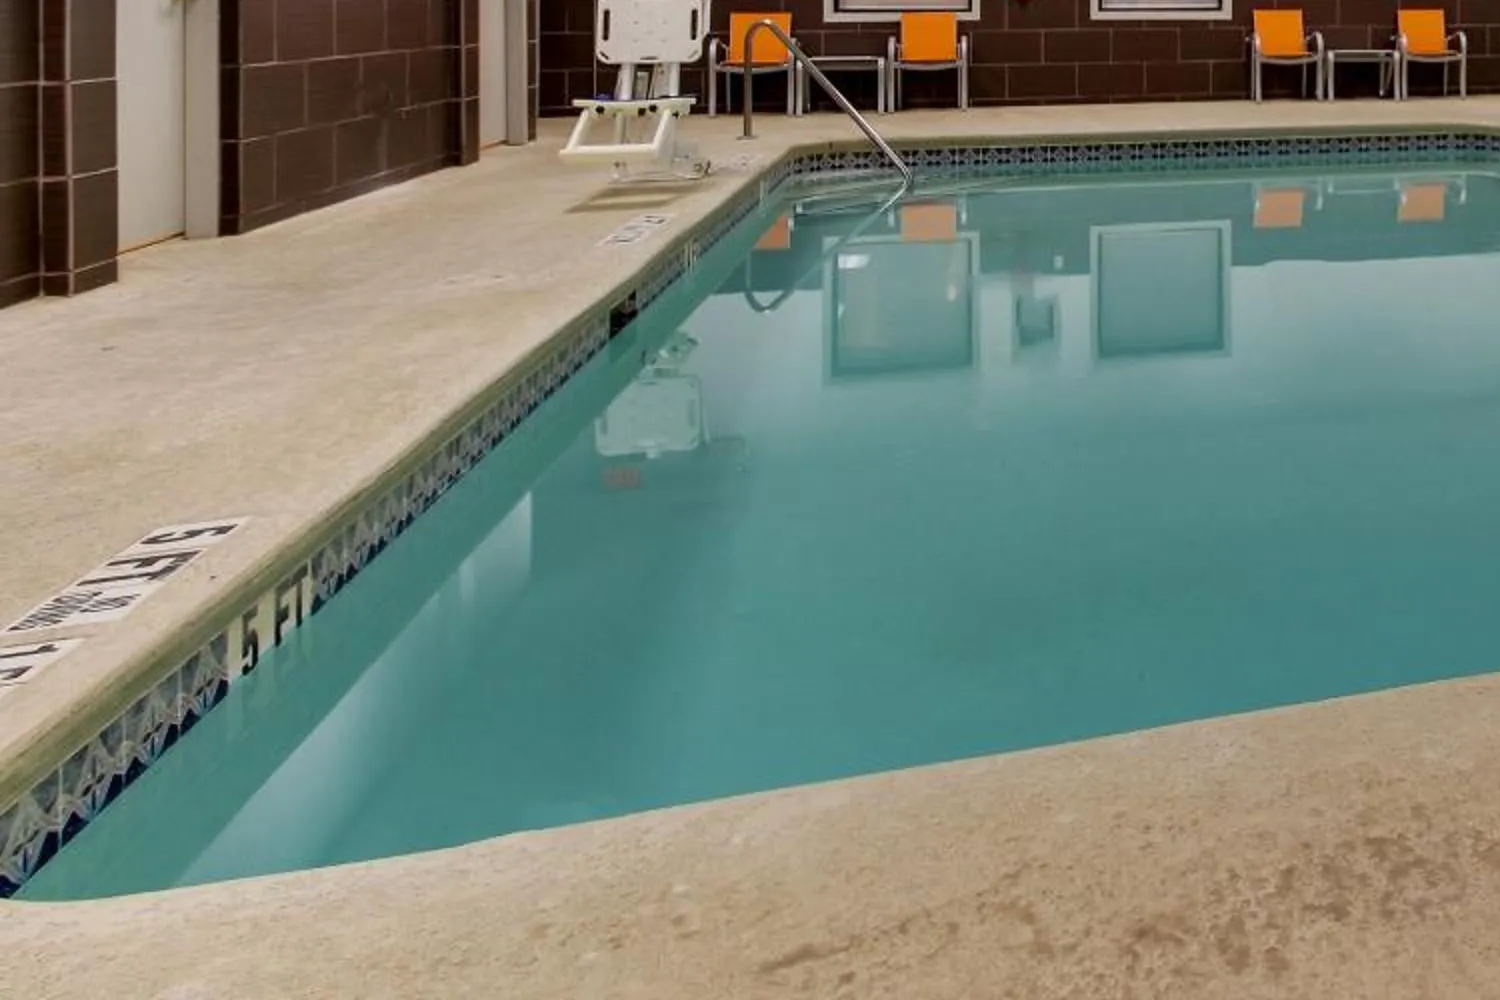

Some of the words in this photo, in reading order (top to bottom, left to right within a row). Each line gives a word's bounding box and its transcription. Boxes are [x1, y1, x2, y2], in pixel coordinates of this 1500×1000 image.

[140, 523, 238, 545] 5
[76, 549, 202, 587] FT
[241, 603, 259, 676] 5
[274, 563, 309, 648] FT
